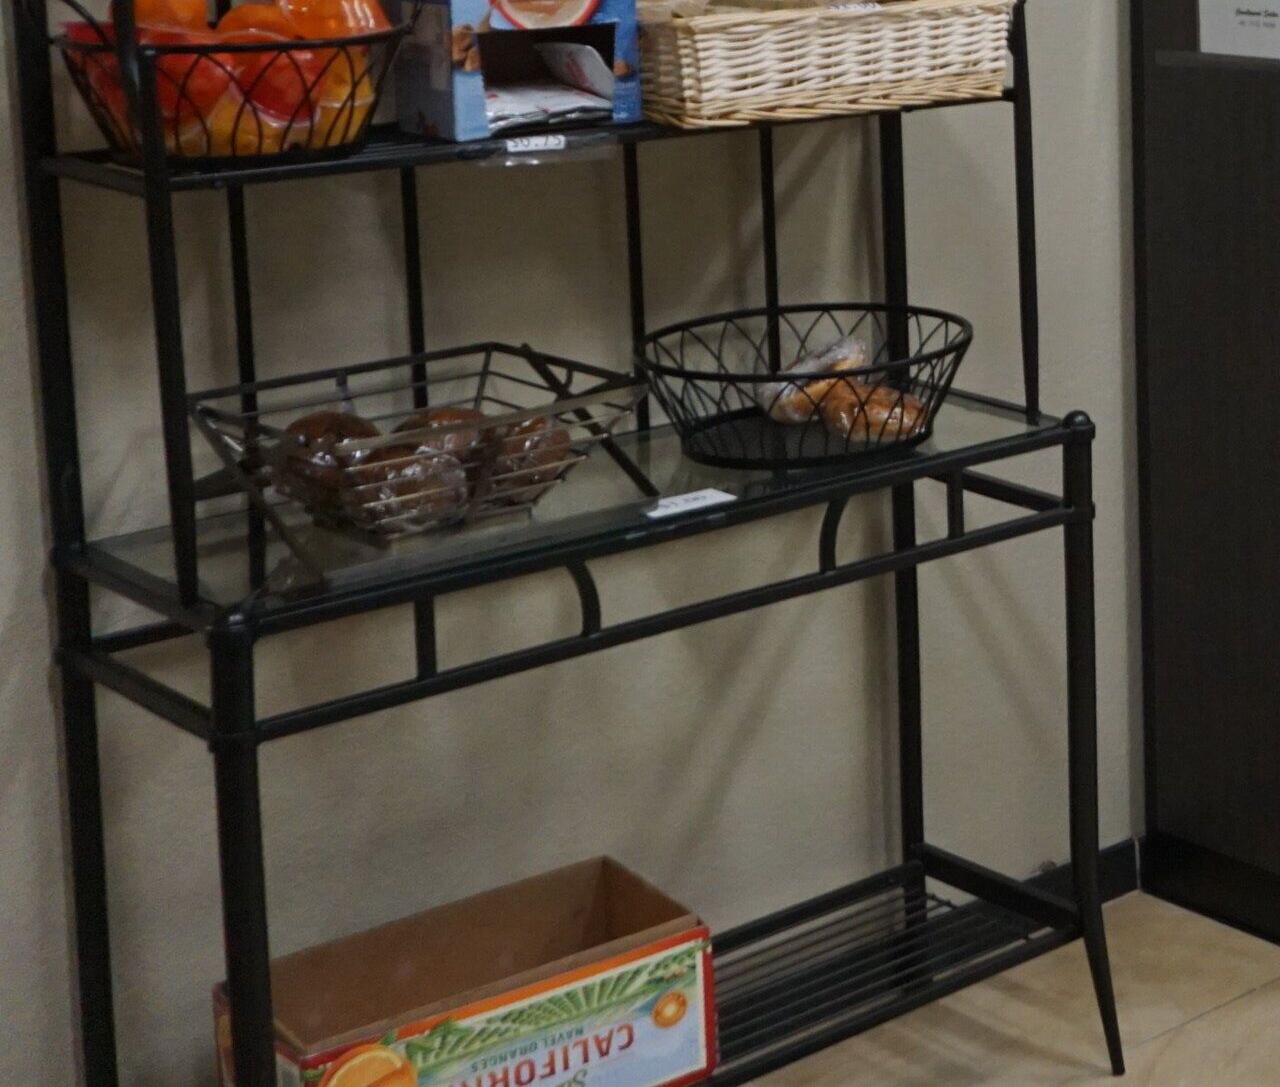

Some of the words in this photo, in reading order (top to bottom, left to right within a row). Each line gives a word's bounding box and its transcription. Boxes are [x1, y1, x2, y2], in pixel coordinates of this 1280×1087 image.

[543, 1025, 584, 1049] NAVEL
[452, 1023, 635, 1087] CALIFOR
[471, 1041, 538, 1073] ORANGES
